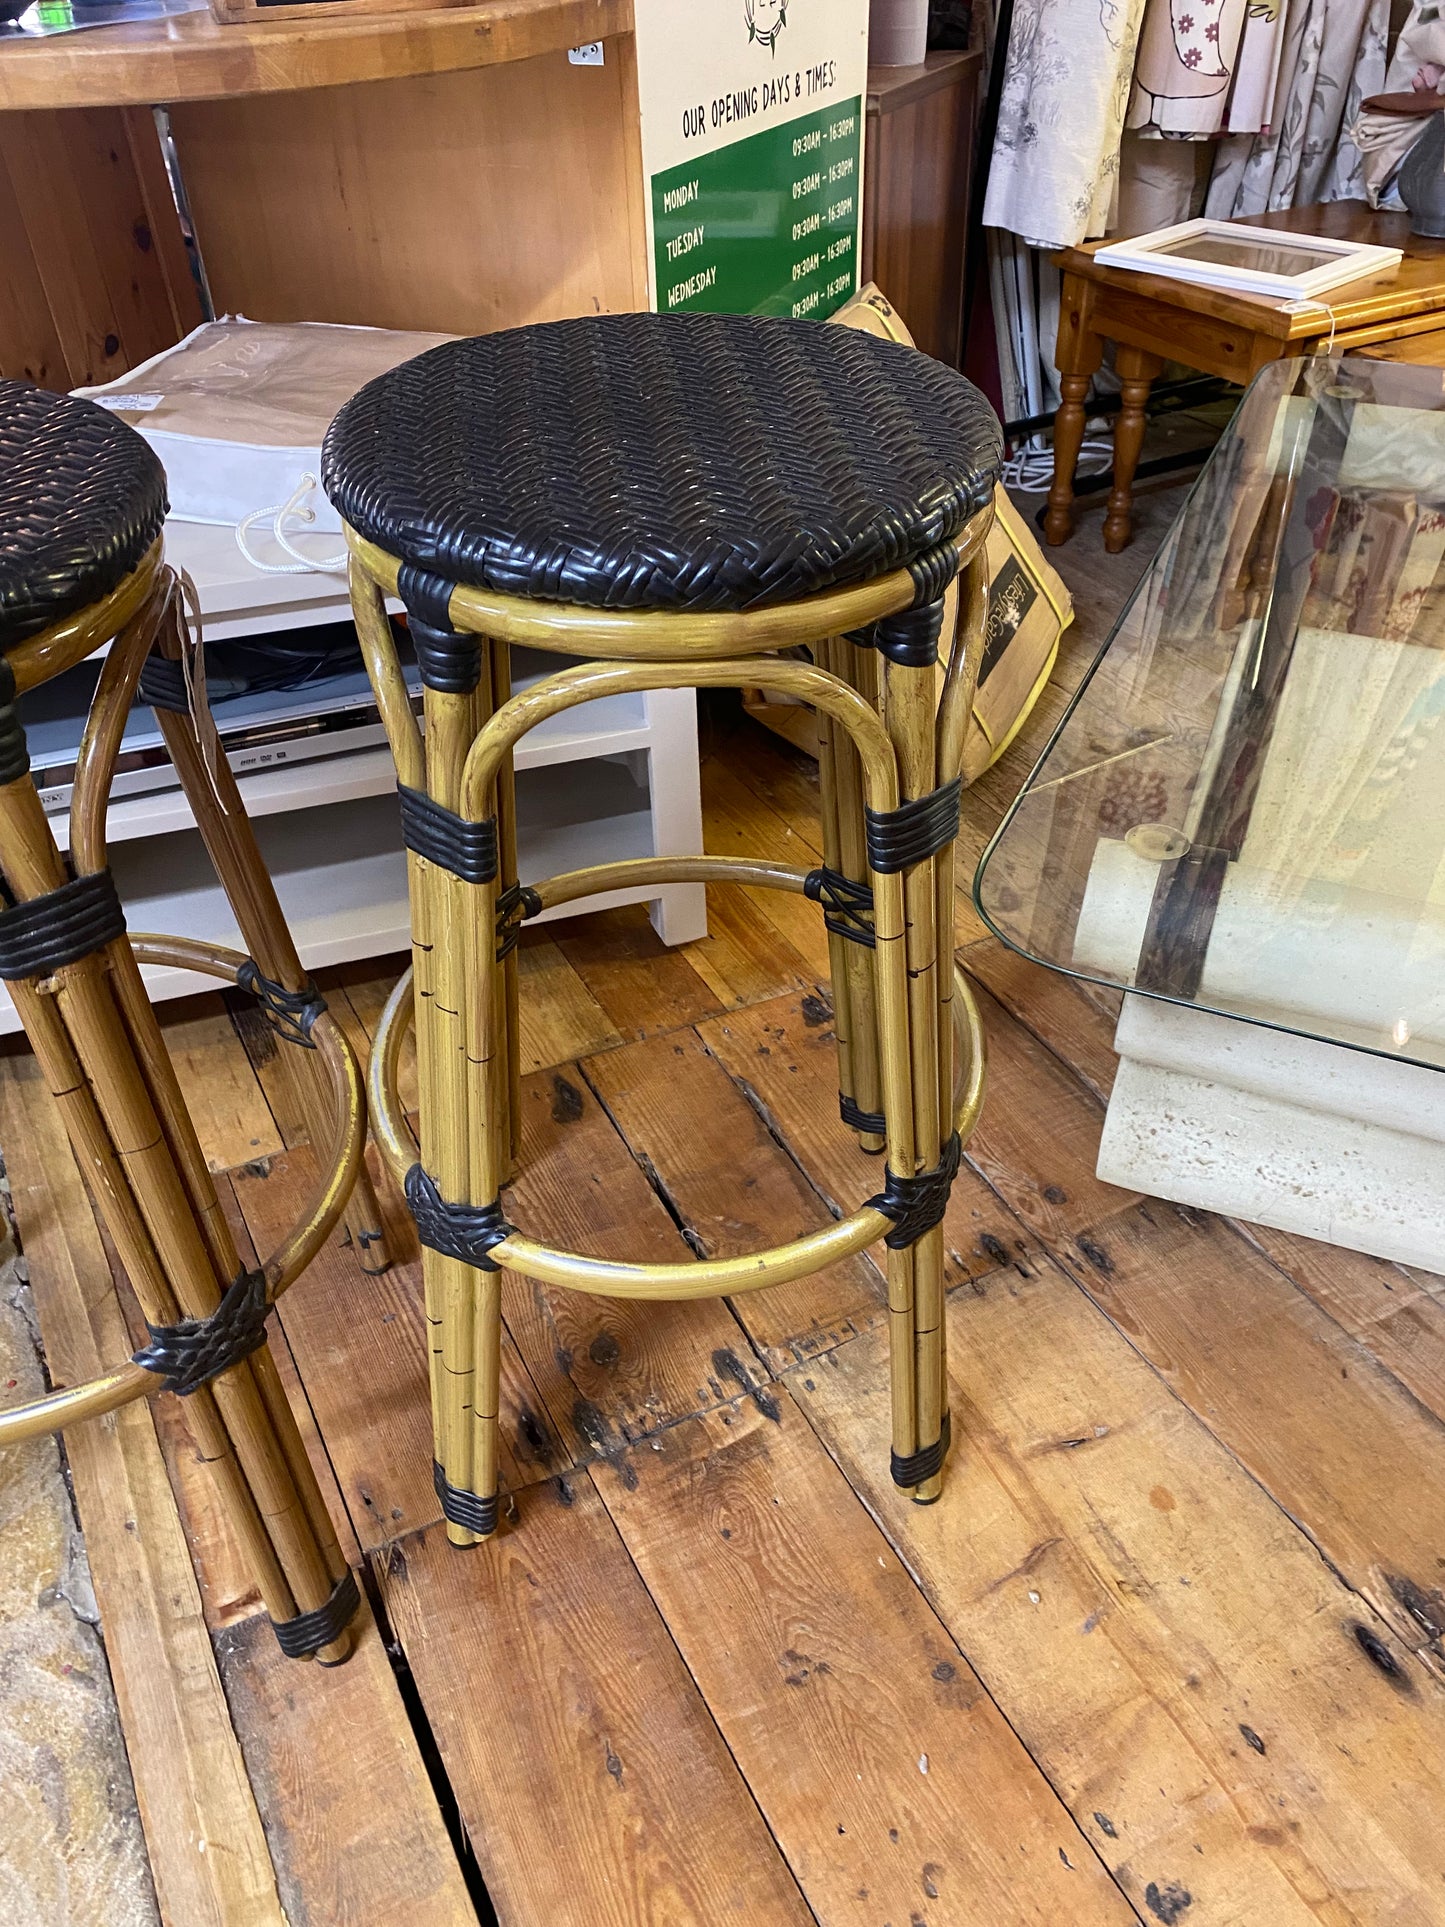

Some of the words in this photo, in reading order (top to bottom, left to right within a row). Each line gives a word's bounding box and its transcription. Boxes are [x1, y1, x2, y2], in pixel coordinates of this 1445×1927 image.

[683, 105, 706, 138] OUR
[711, 86, 758, 128] OPENING
[763, 74, 790, 111] DAYS
[794, 72, 801, 98] &
[806, 60, 837, 96] TIMES:
[663, 179, 699, 214] MONDAY
[666, 225, 704, 262] TUESDAY
[667, 265, 717, 308] WEDNESDAY
